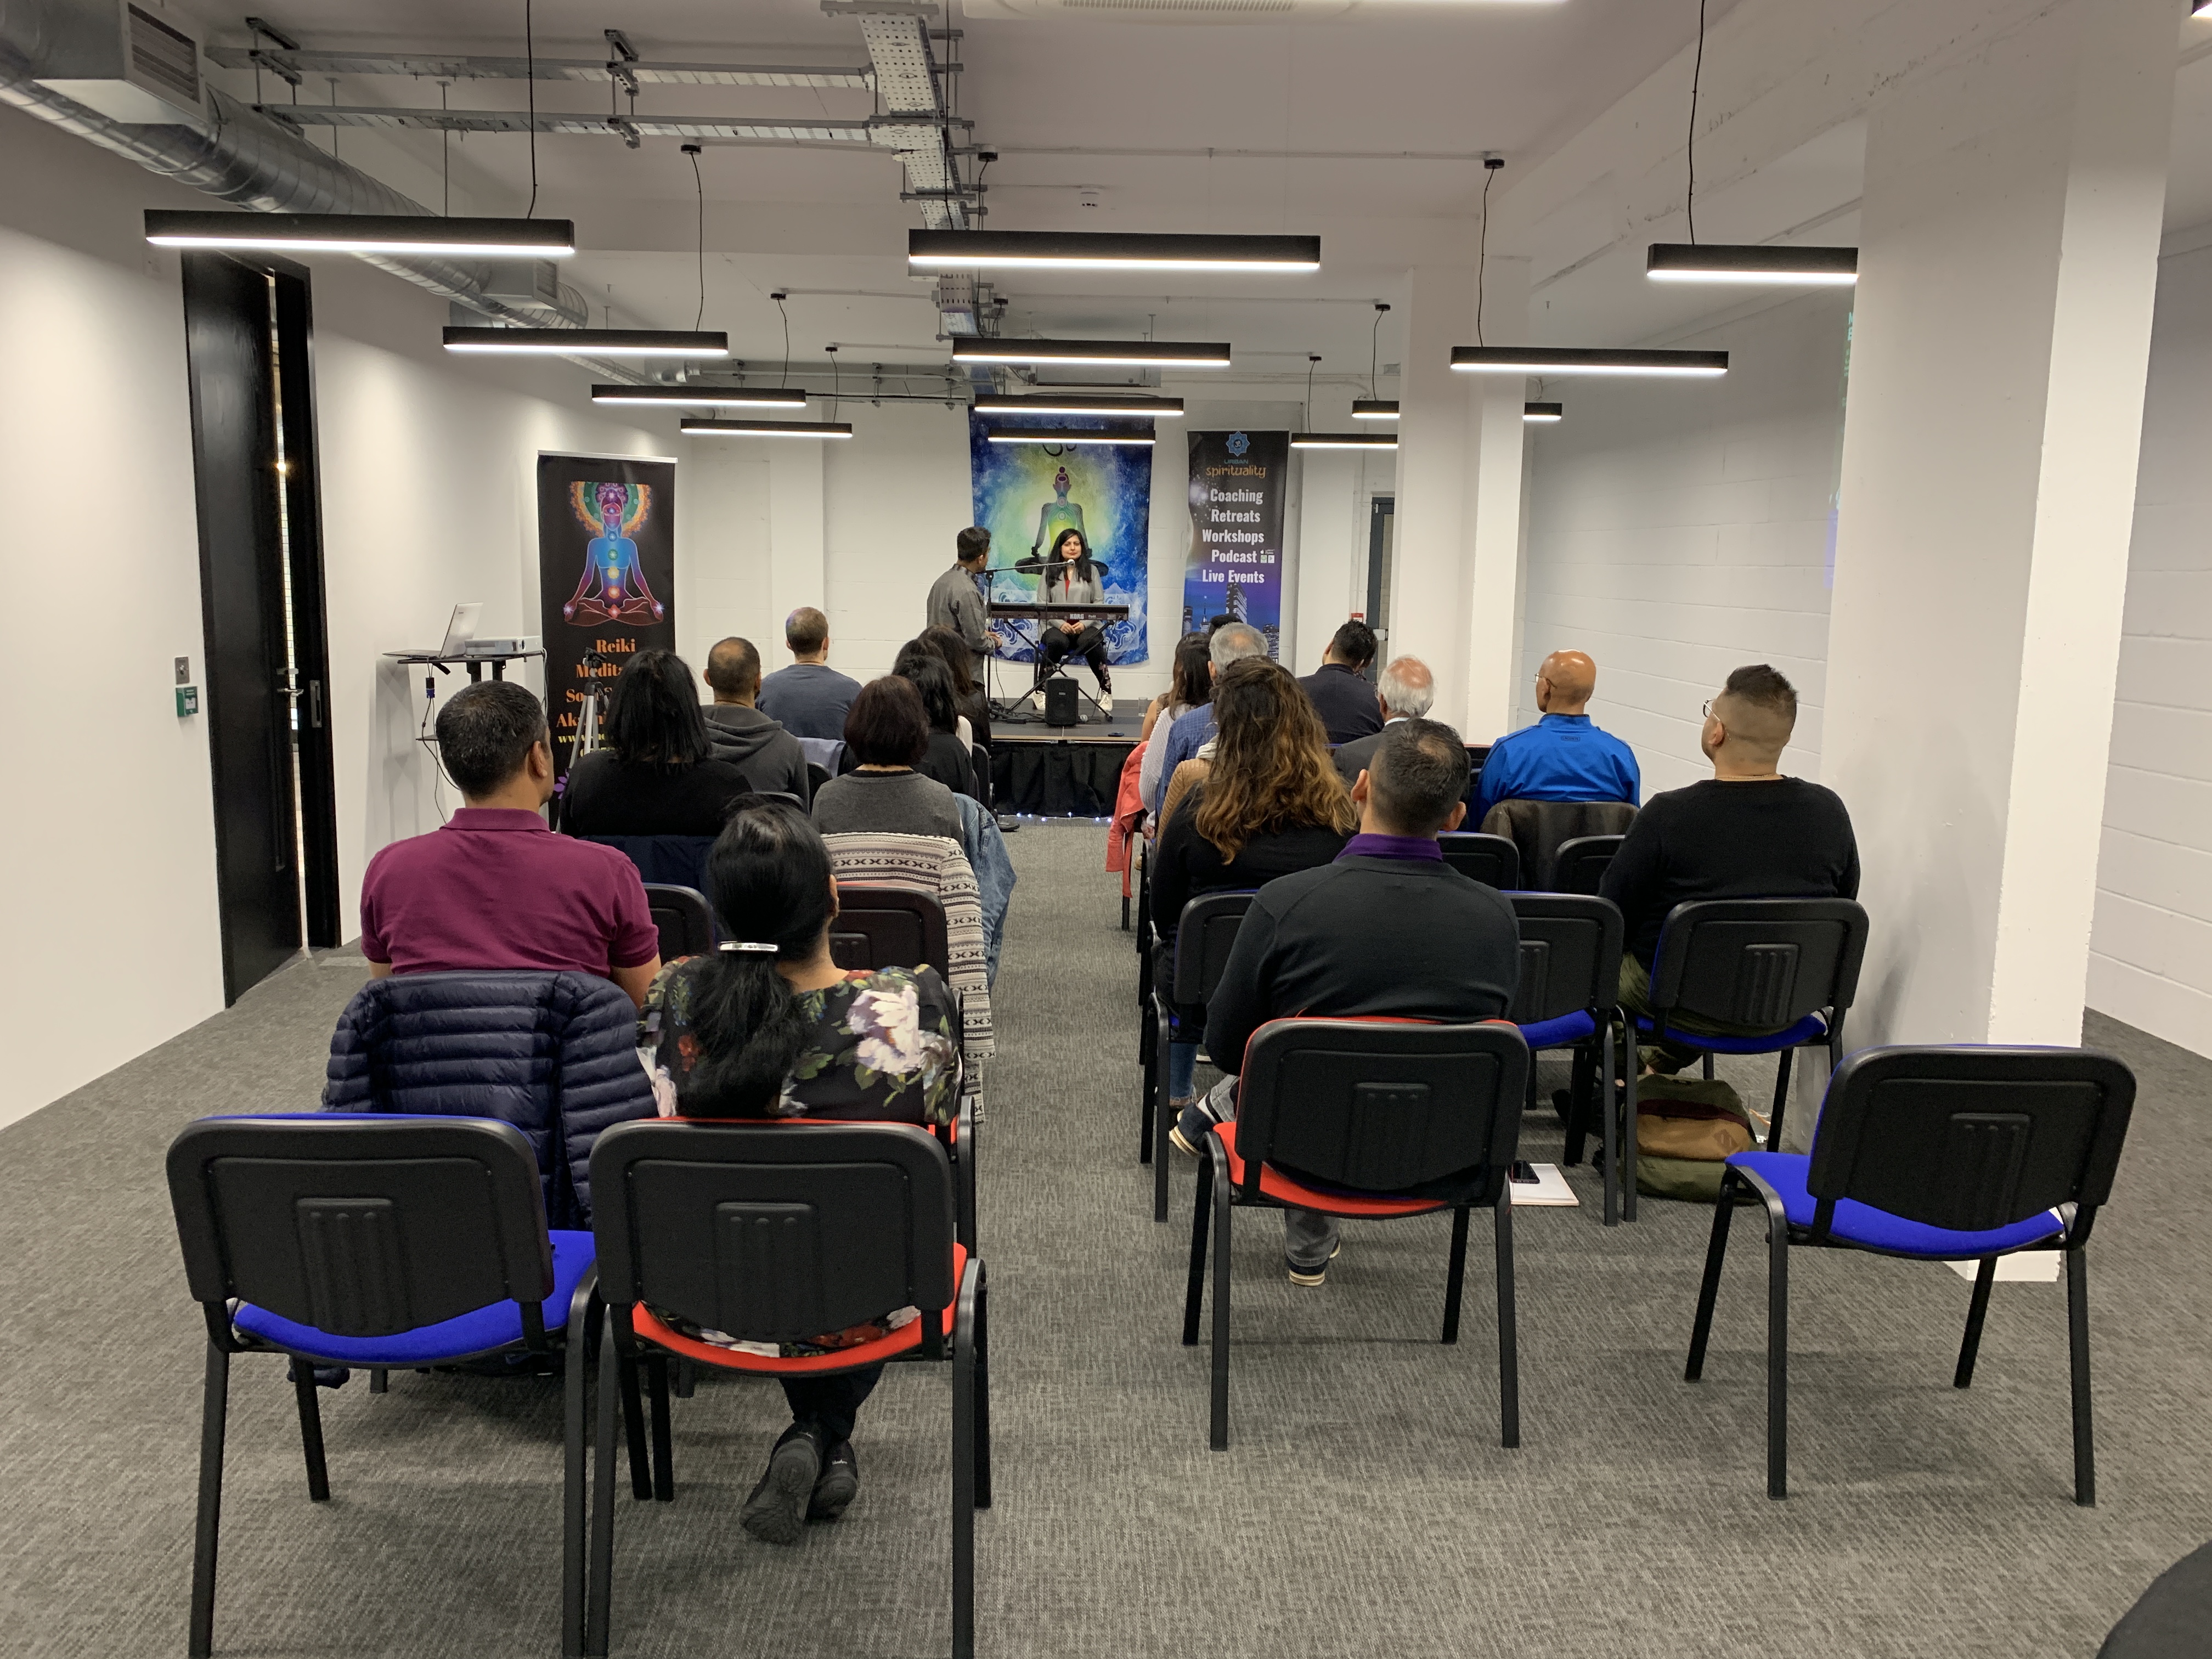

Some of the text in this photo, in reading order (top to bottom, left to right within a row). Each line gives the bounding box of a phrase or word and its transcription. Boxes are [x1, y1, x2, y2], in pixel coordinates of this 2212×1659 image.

[1205, 465, 1266, 479] spirituality
[1210, 488, 1263, 505] Coaching
[1211, 509, 1261, 522] Retreats
[1202, 529, 1265, 545] Workshops
[1211, 549, 1257, 563] Podcast
[1202, 569, 1265, 583] Live Events
[596, 638, 635, 653] Reiki
